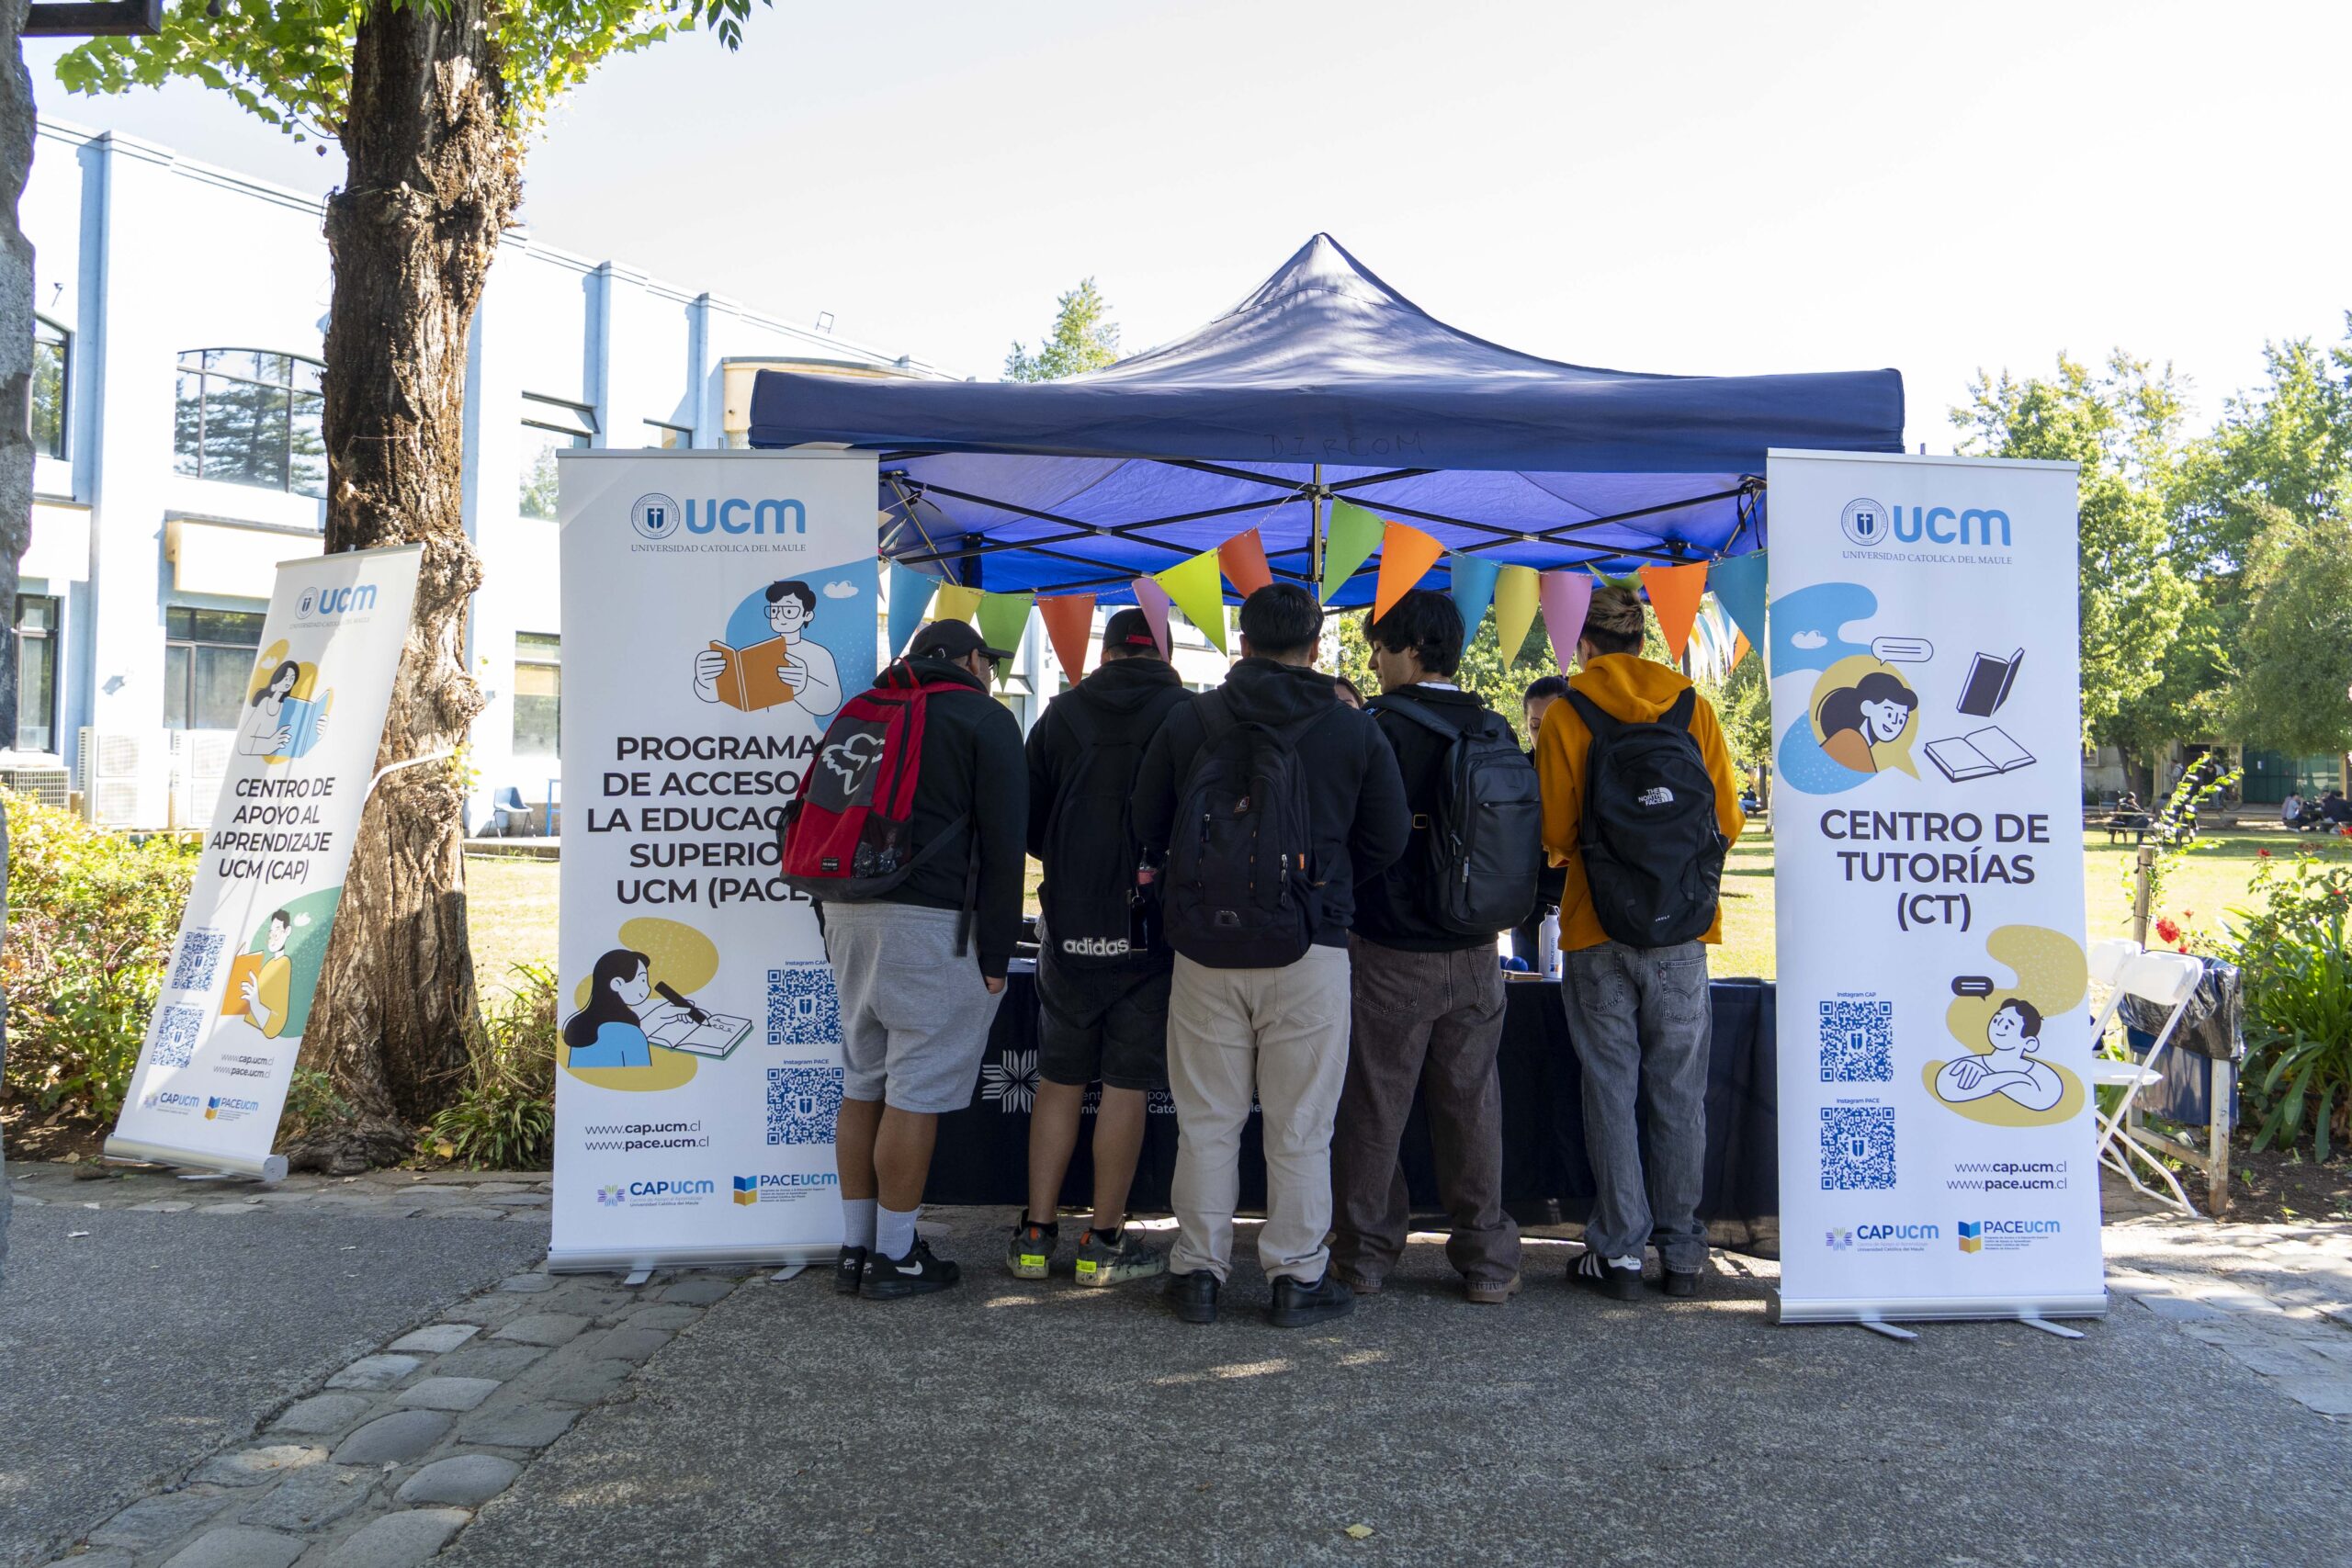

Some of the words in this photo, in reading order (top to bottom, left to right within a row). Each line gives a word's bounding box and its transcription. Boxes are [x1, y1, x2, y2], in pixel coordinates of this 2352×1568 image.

[631, 544, 699, 552] UNIVERSIDAD
[700, 544, 751, 553] CATOLICA
[772, 544, 806, 552] MAULE
[1842, 551, 1905, 562] UNIVERSIDAD
[1907, 553, 1956, 564] CATOLICA
[1958, 555, 1976, 564] DEL
[1978, 556, 2012, 565] MAULE
[616, 736, 815, 761] PROGRAMA
[235, 778, 310, 798] CENTRO
[311, 776, 336, 797] DE
[603, 772, 651, 796] DE
[659, 770, 801, 796] ACCESO
[1638, 793, 1661, 803] NORTH
[1645, 798, 1662, 807] FACE
[232, 805, 300, 825] APOYO
[300, 805, 321, 825] AL
[587, 807, 632, 832] LA
[641, 806, 783, 831] EDUCAC
[1820, 808, 1983, 842] CENTRO
[1995, 813, 2050, 843] DE
[209, 830, 333, 852] APRENDIZAJE
[629, 841, 782, 868] SUPERIO
[219, 858, 264, 879] UCM
[266, 859, 310, 885] (CAP)
[1837, 846, 2036, 885] TUTORÍAS
[616, 878, 697, 905] UCM
[1897, 892, 1972, 932] (CT)
[1063, 937, 1130, 955] adidas
[220, 1054, 275, 1066] www.cap.ucm.cl
[213, 1066, 271, 1079] www.pace.ucm.cl
[584, 1120, 701, 1135] www.cap.ucm.cl
[584, 1135, 709, 1152] www.pace.ucm.cl
[1954, 1161, 2067, 1175] www.cap.ucm.cl
[1946, 1178, 2067, 1191] www.pace.ucm.cl
